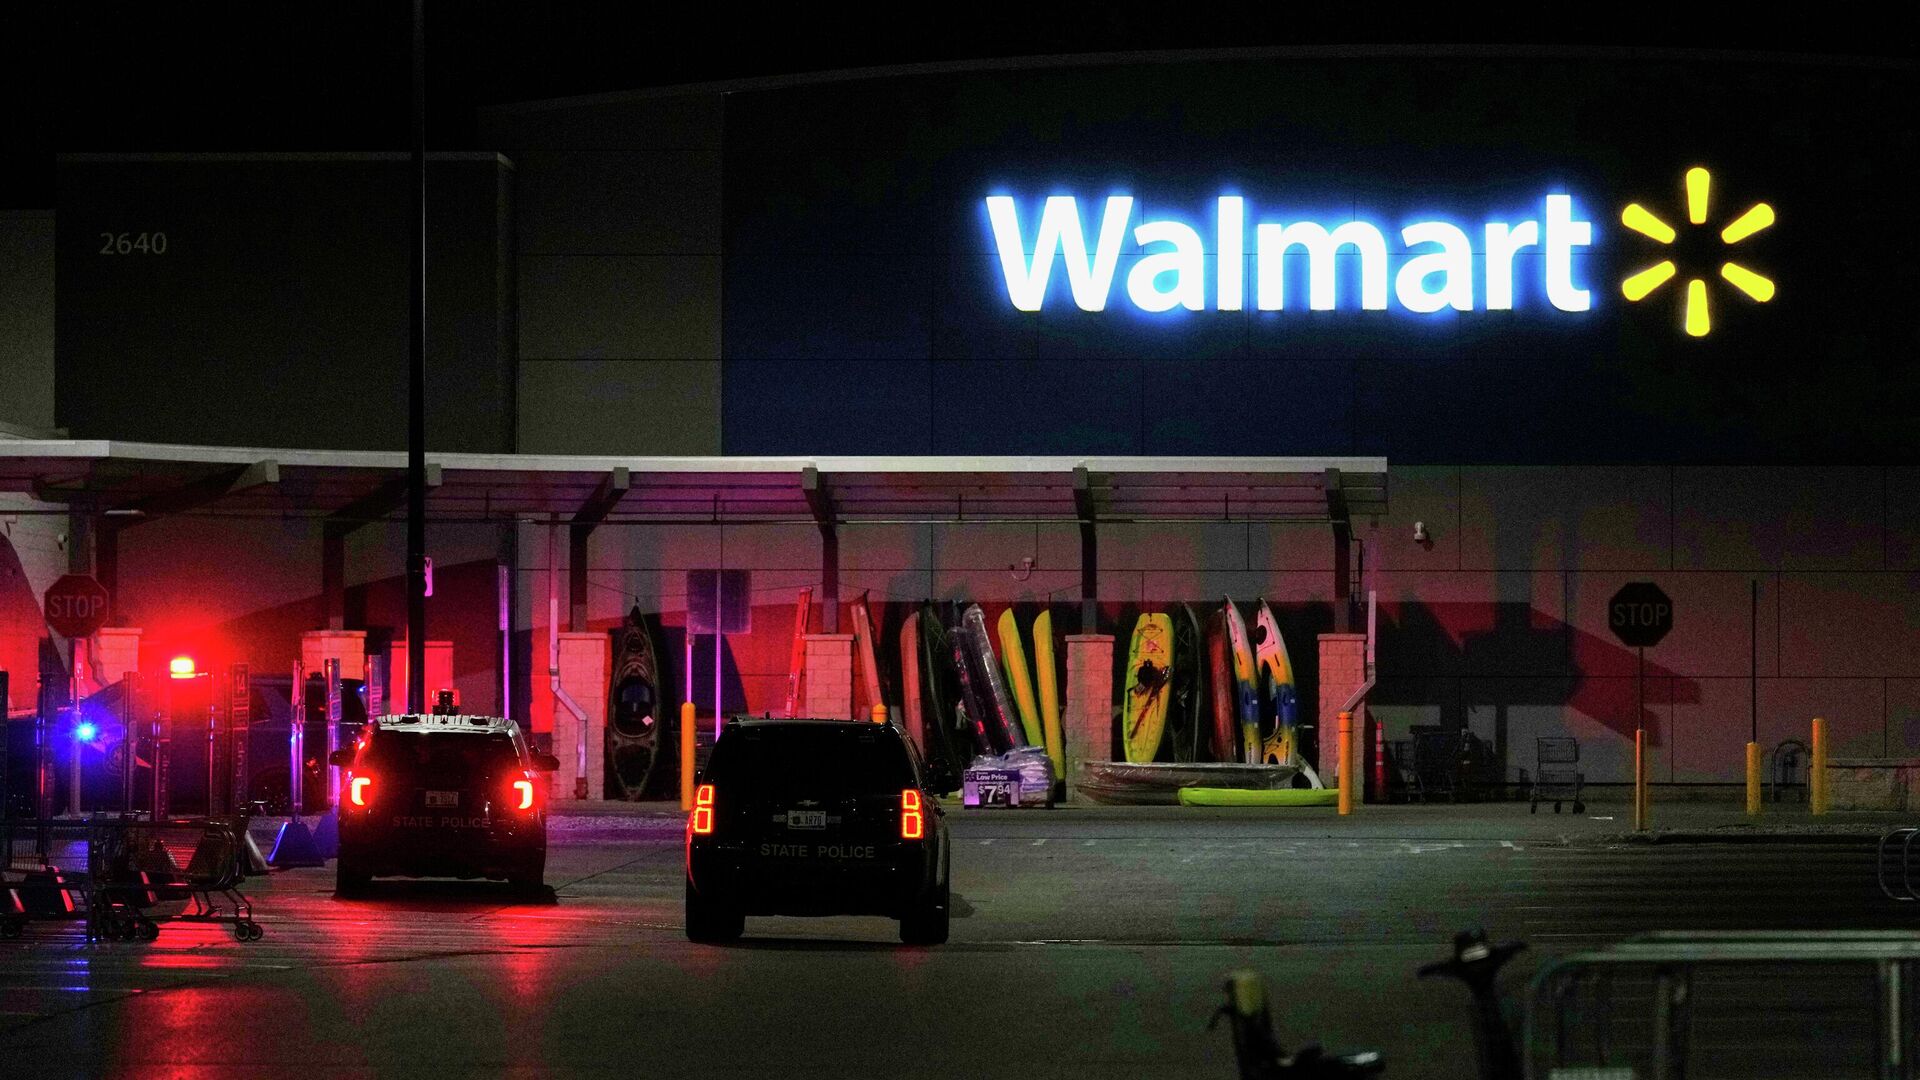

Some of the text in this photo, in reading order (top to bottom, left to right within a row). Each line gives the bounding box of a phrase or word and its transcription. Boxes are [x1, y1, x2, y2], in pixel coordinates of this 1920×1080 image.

[99, 232, 167, 254] 2640
[985, 194, 1592, 312] Walmart
[49, 595, 104, 618] STOP
[1612, 602, 1669, 626] STOP
[392, 816, 489, 828] STATE POLICE
[760, 843, 875, 859] STATE POLICE
